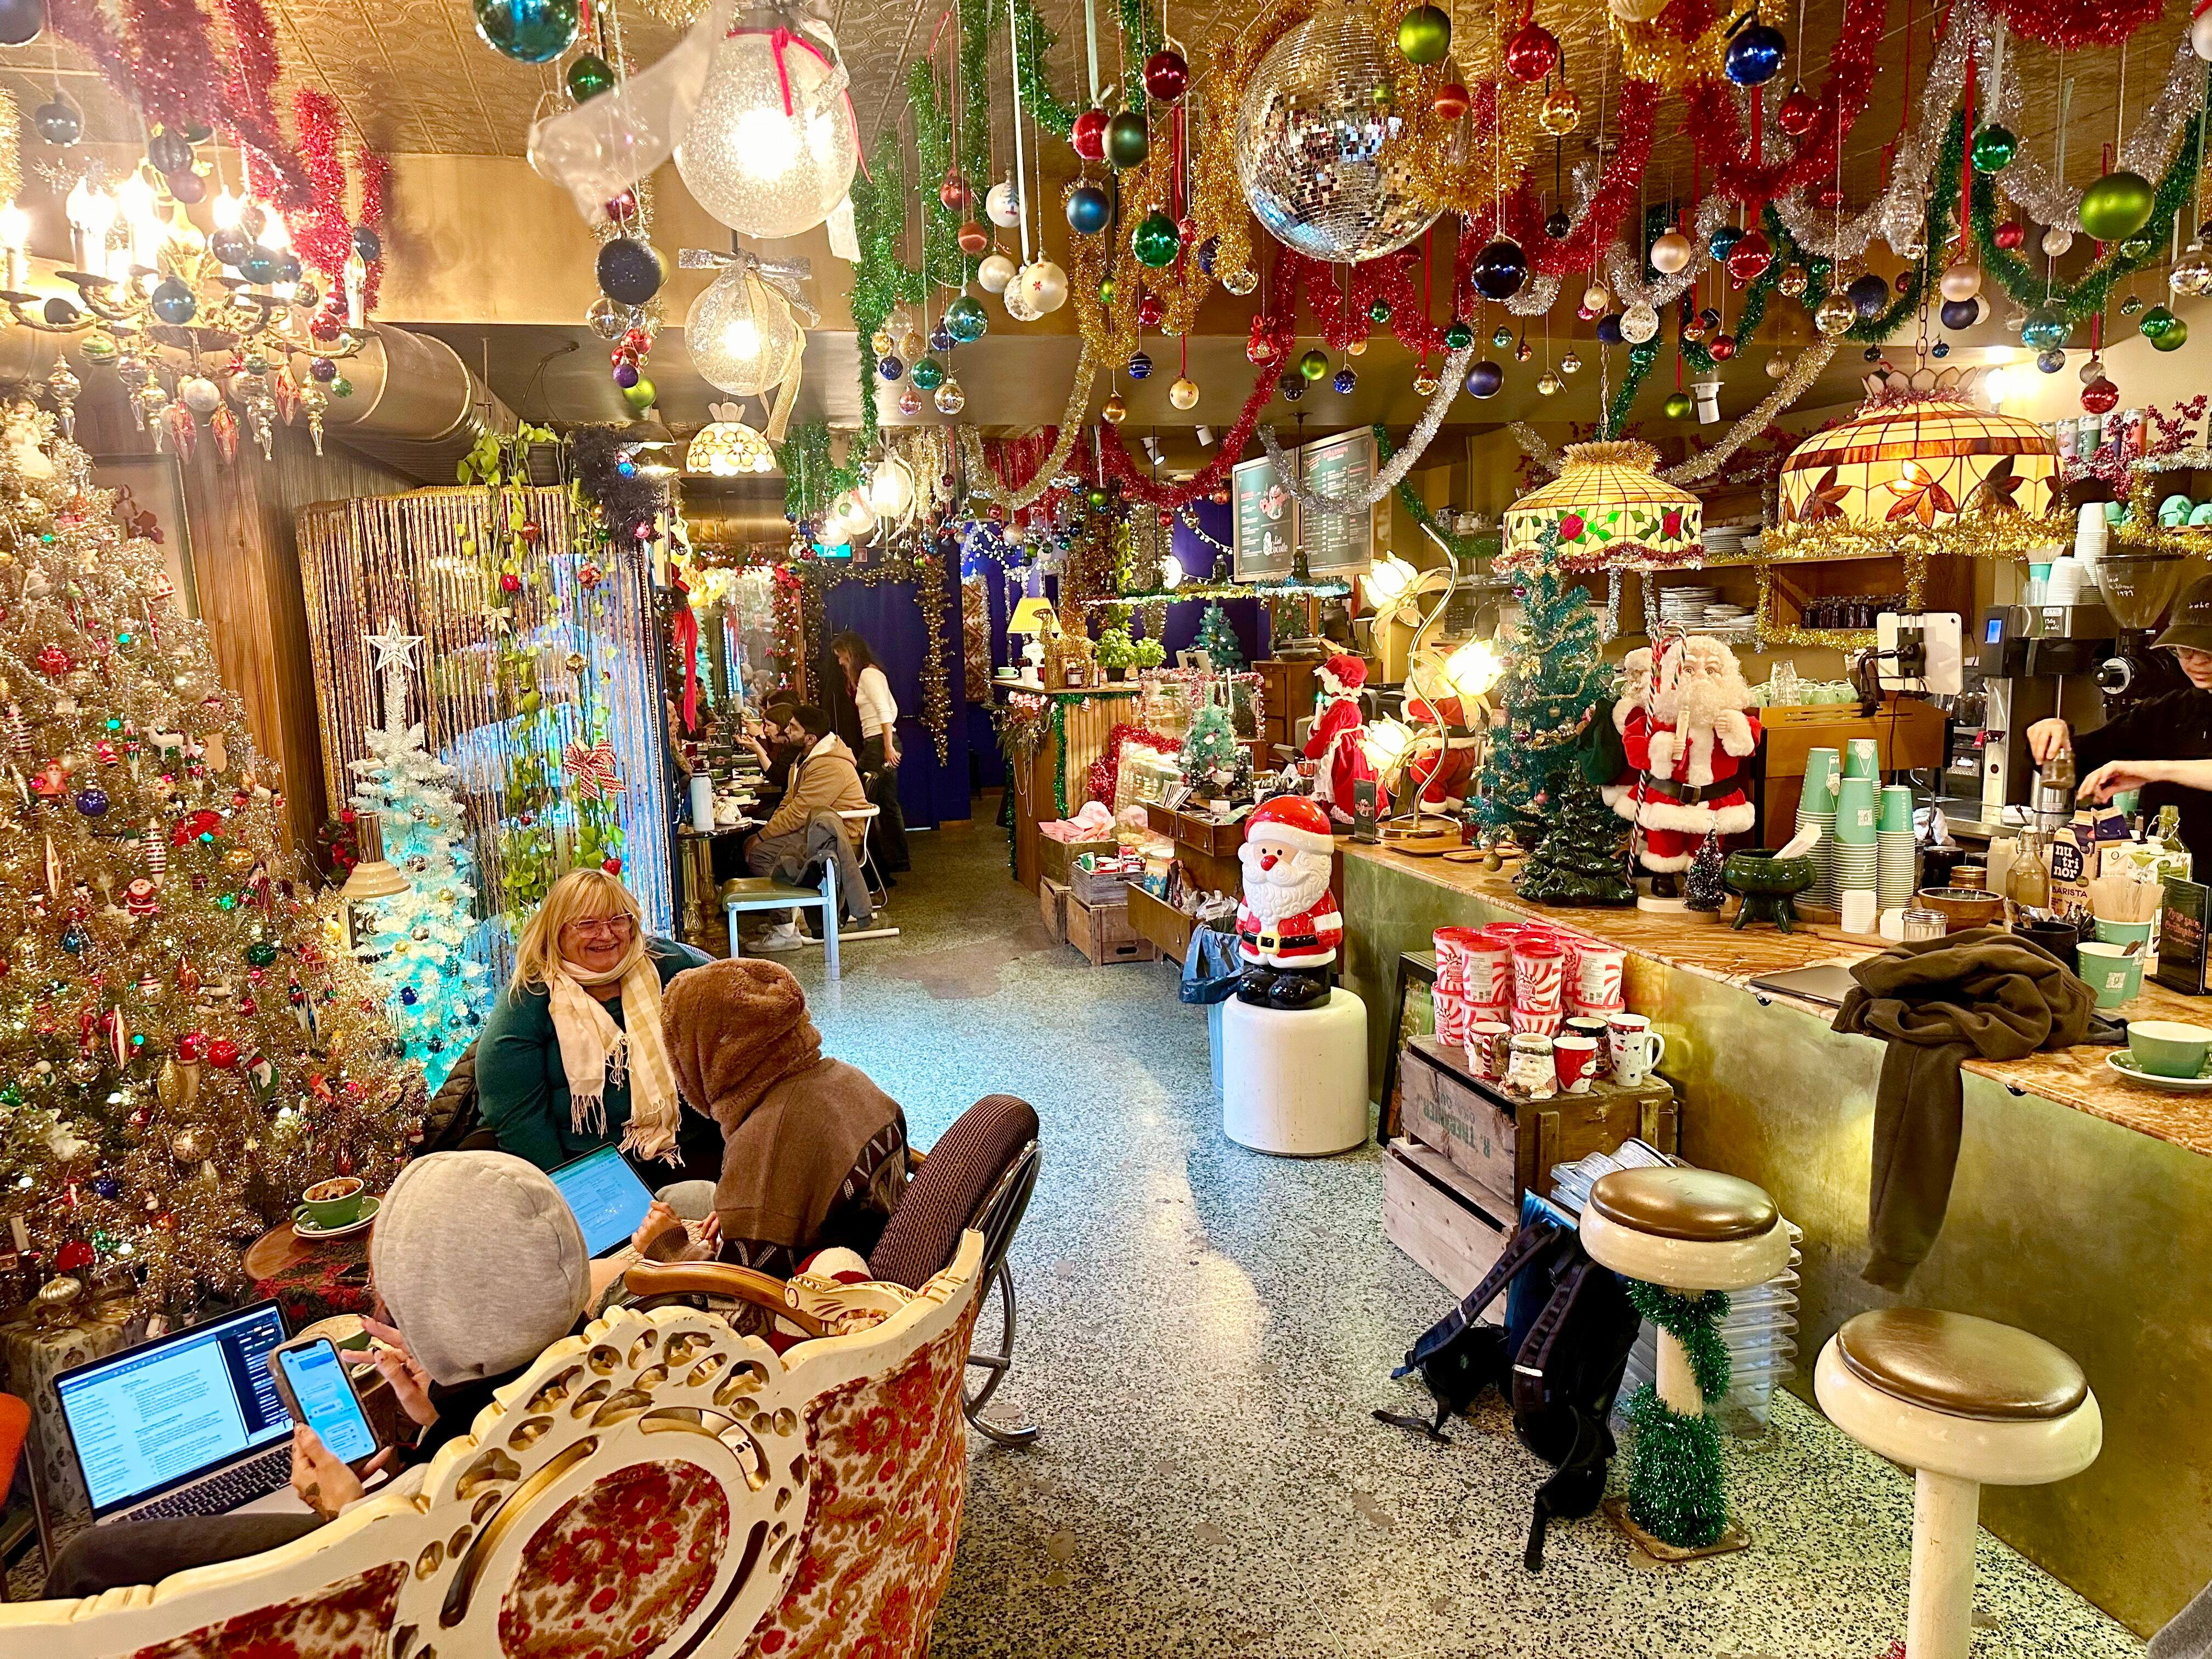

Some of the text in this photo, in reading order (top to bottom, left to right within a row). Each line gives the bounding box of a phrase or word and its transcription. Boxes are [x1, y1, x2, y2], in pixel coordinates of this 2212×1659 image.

[2055, 845, 2073, 857] nu
[2062, 856, 2079, 869] tri
[2053, 866, 2077, 878] nor
[2052, 885, 2087, 898] BARISTA
